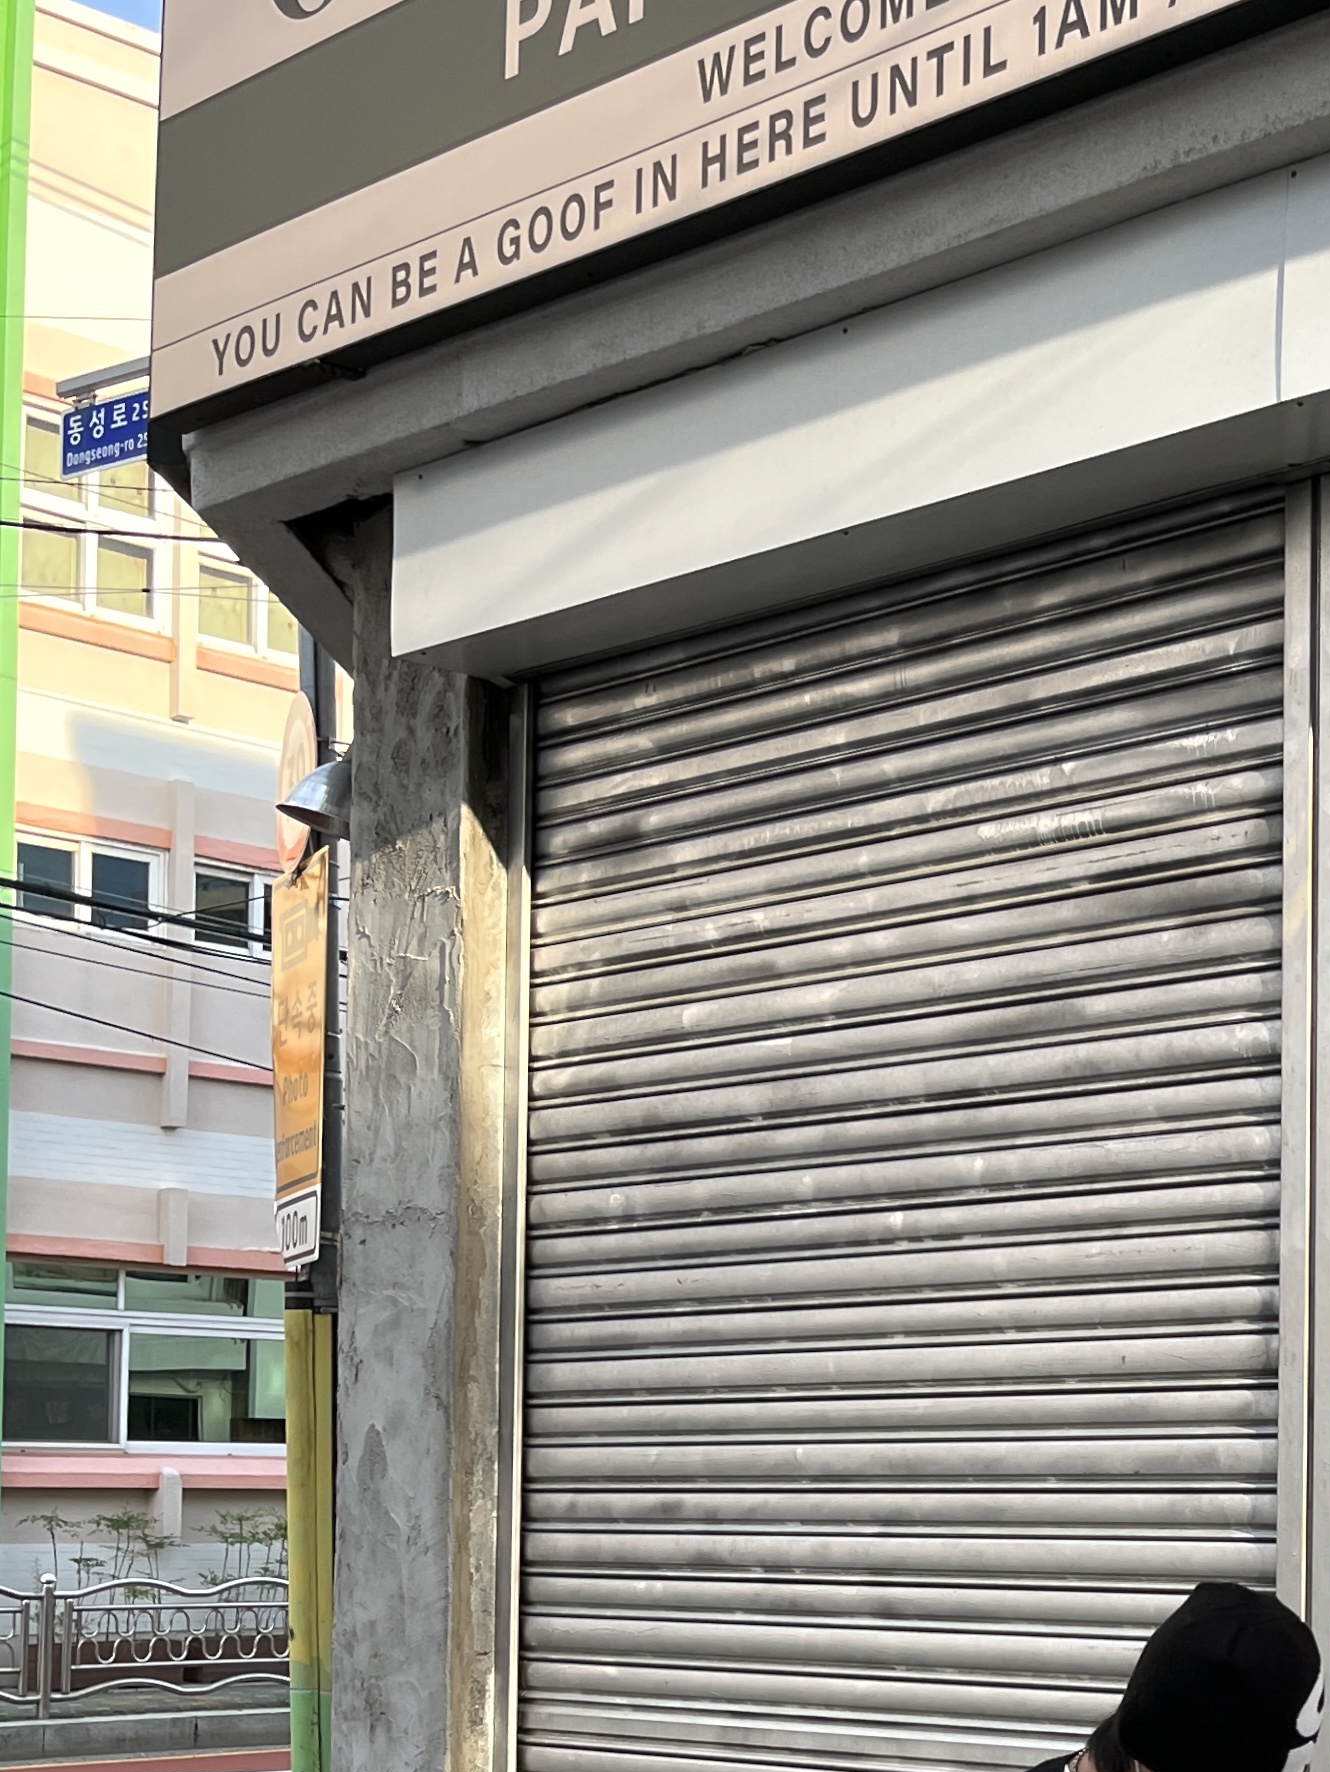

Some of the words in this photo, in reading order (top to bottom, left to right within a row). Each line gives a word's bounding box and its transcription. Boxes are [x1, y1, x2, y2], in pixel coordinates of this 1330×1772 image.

[211, 312, 282, 376] YOU
[298, 276, 372, 343] CAN
[392, 250, 438, 309] BE
[455, 236, 479, 284] A
[498, 179, 615, 266] GOOF
[635, 153, 677, 215] IN
[702, 93, 827, 189] HERE
[851, 25, 1008, 128] UNTIL
[67, 402, 128, 445] 동성로
[66, 438, 135, 467] Dongseong-ro
[278, 981, 318, 1047] 단속중
[282, 1069, 309, 1106] Photo
[281, 1210, 308, 1251] 100m
